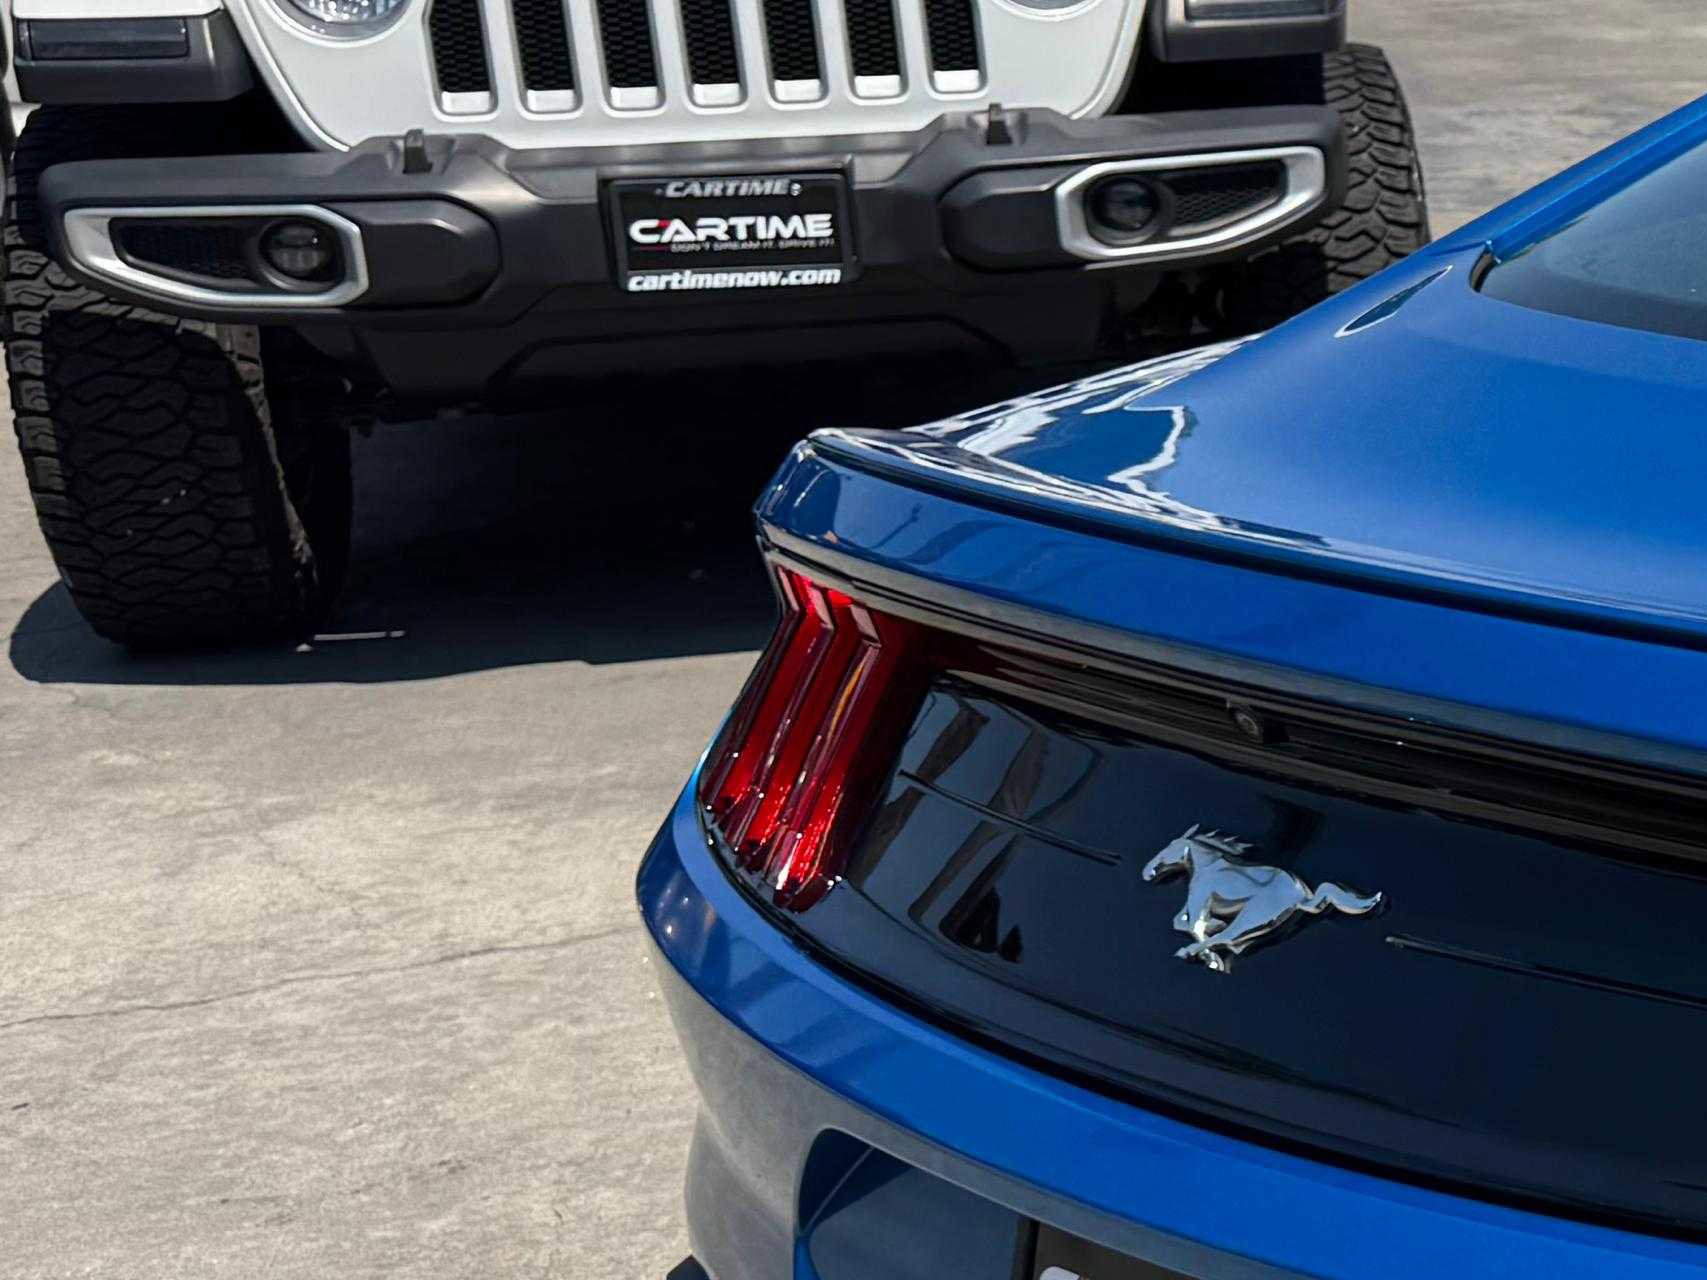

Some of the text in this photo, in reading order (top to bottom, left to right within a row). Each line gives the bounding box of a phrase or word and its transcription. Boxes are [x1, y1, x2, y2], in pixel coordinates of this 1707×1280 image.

[666, 178, 791, 198] CARTIME
[629, 213, 835, 244] CARTIME
[627, 268, 842, 291] cartimenow.com
